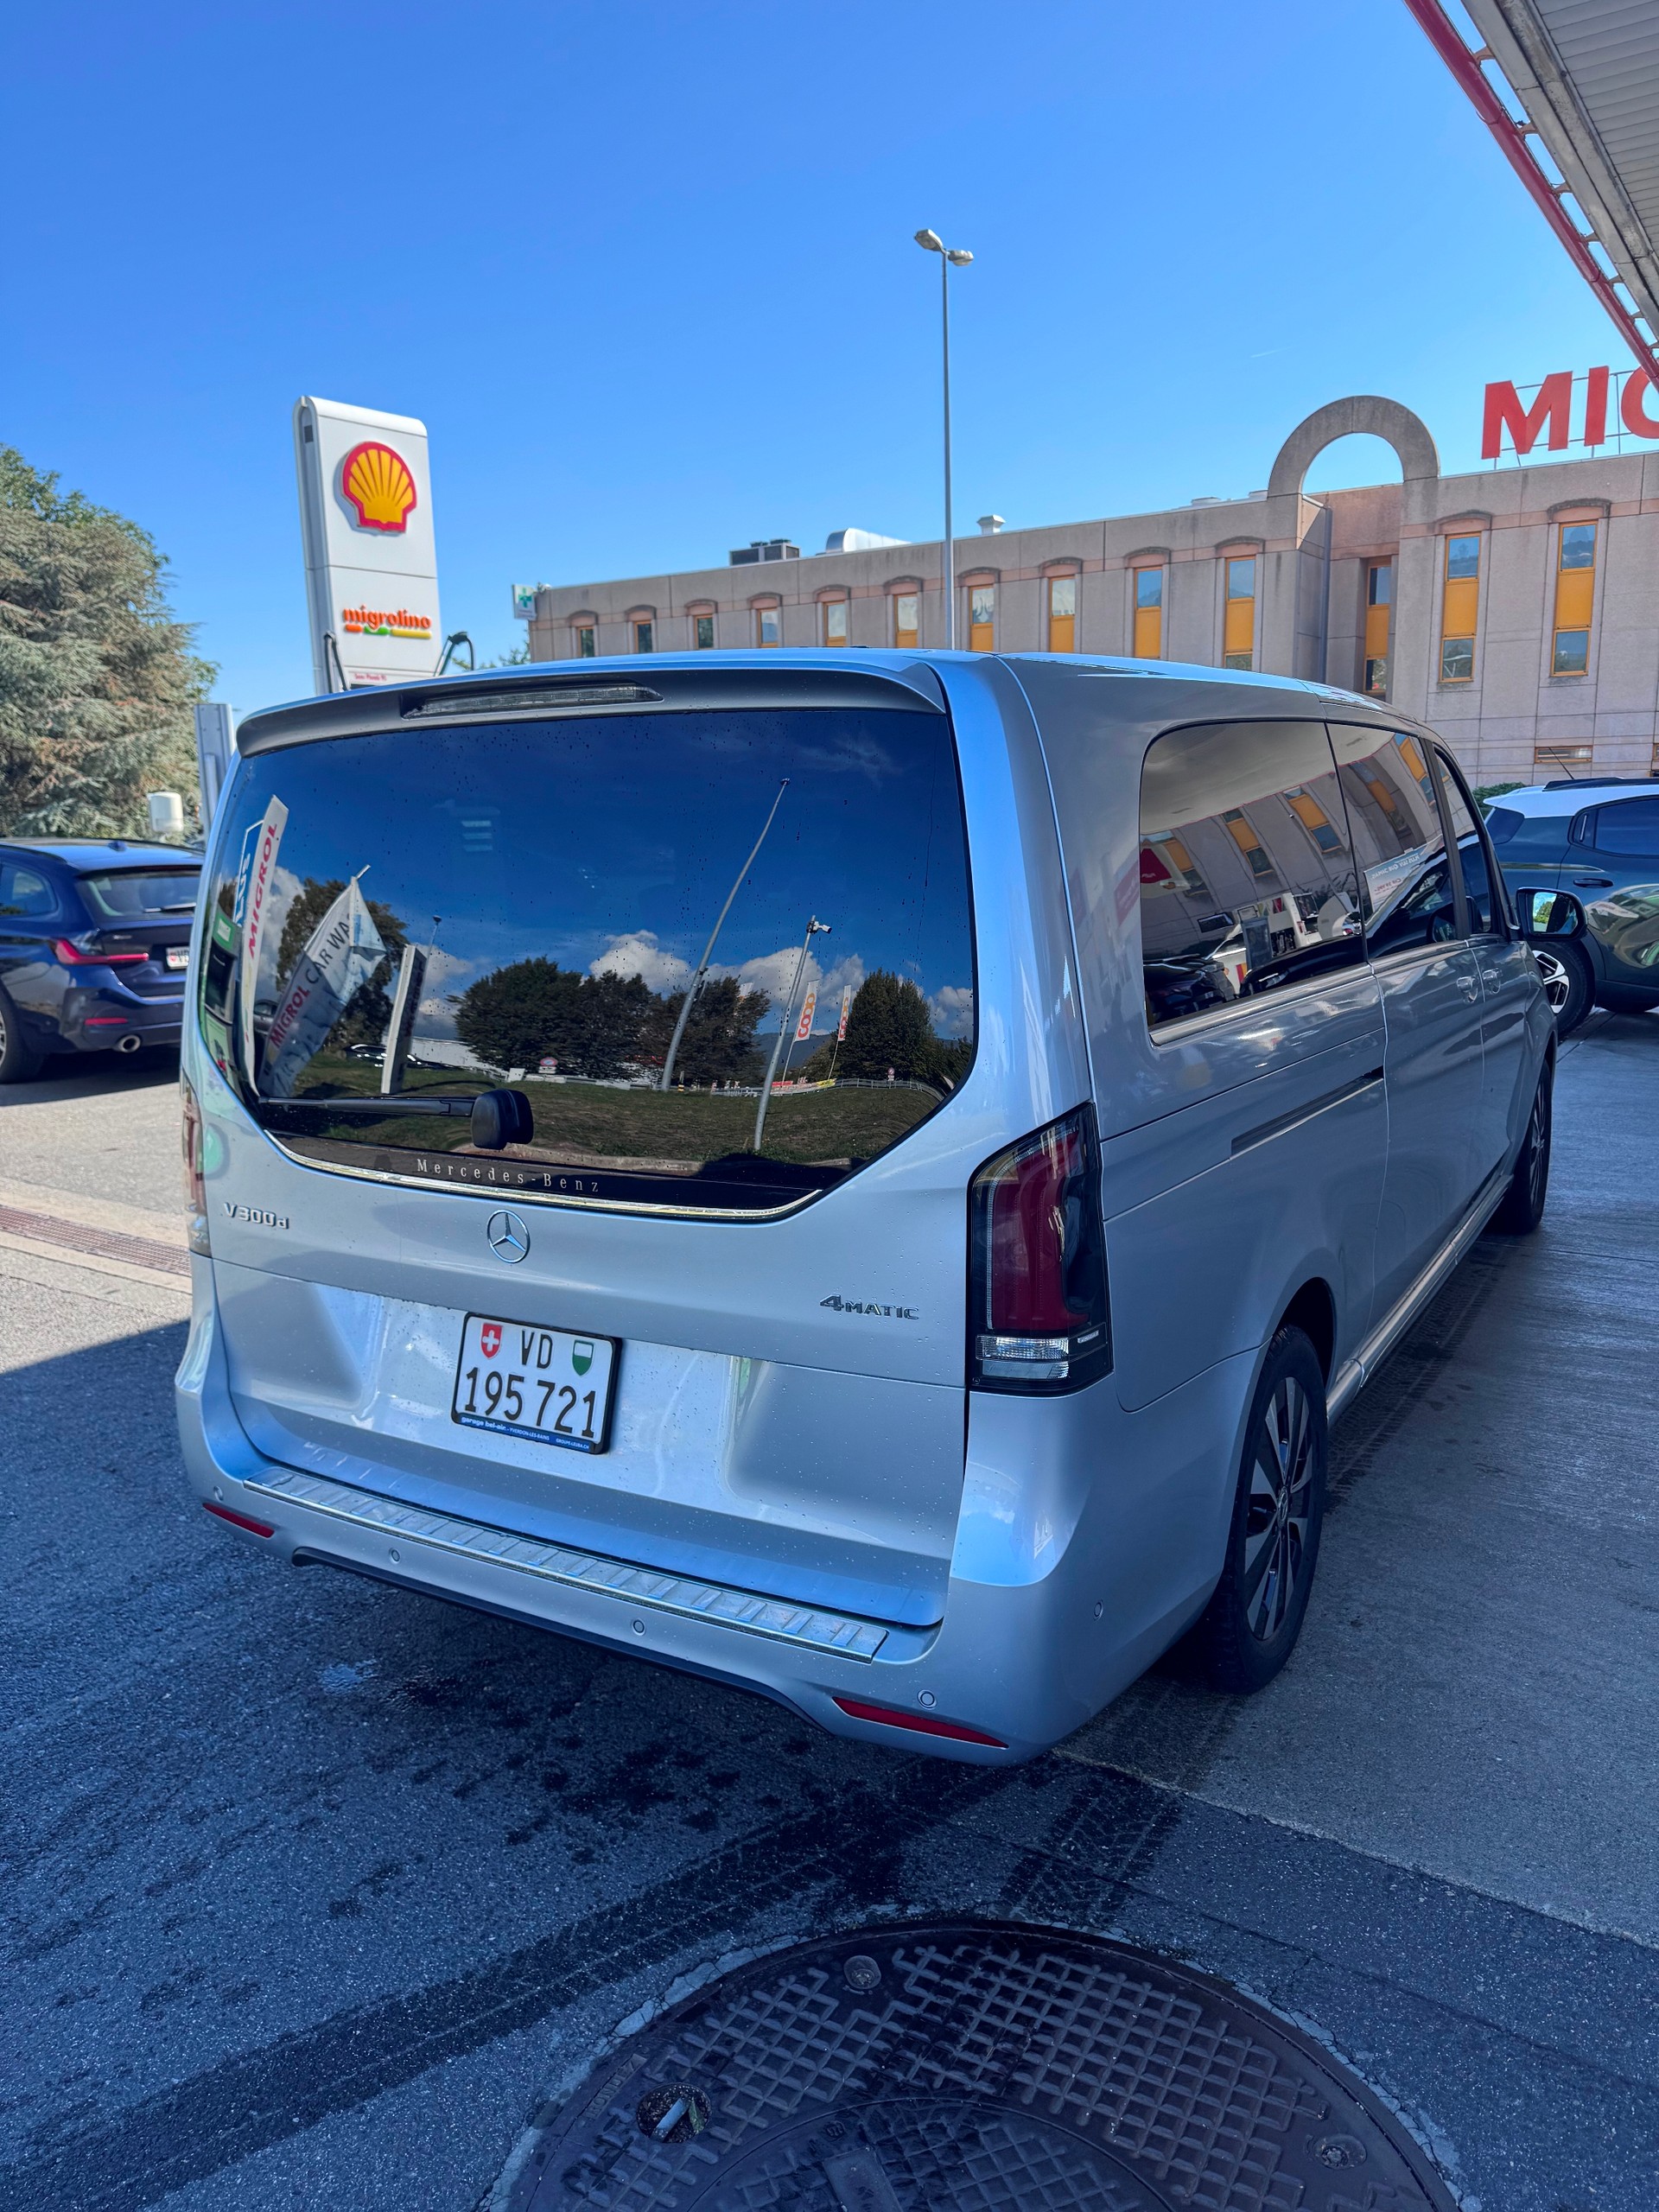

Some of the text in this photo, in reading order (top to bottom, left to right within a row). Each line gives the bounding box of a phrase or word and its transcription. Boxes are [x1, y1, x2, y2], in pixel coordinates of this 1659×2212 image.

[342, 604, 431, 630] migrolino
[248, 823, 277, 960] MIGROL
[269, 985, 311, 1049] MIGROL
[305, 948, 333, 985] CAR
[797, 993, 817, 1039] coop
[819, 1294, 919, 1320] 4MATIC
[521, 1329, 554, 1370] VD
[461, 1416, 484, 1427] garage
